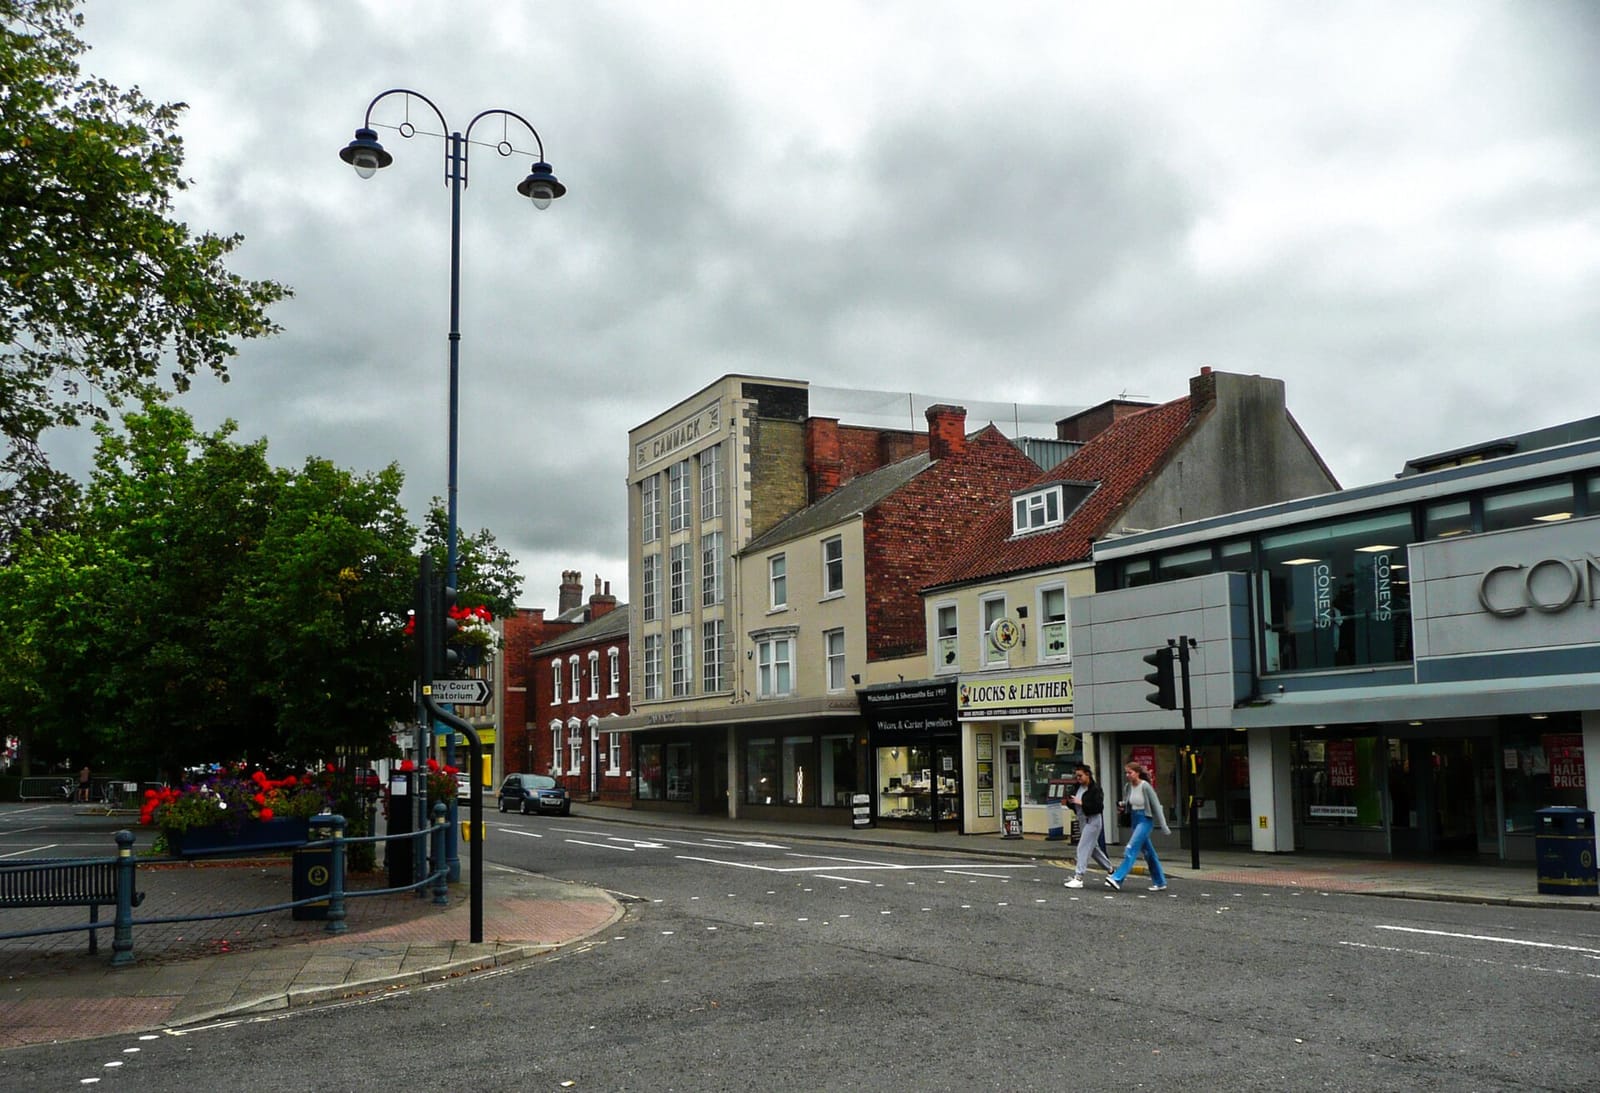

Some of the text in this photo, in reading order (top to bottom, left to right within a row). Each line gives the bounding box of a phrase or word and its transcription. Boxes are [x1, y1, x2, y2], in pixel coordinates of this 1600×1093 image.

[653, 418, 700, 458] CAMMACK
[1378, 555, 1392, 621] CONEYS
[1318, 565, 1331, 628] CONEYS
[449, 682, 474, 690] Court
[973, 681, 1068, 702] LOCKS & LEATHER
[924, 717, 953, 730] Jewellers
[1331, 767, 1354, 776] HALF
[1553, 764, 1584, 775] HALF
[1331, 776, 1355, 786] PRICE
[1553, 775, 1585, 787] PRICE
